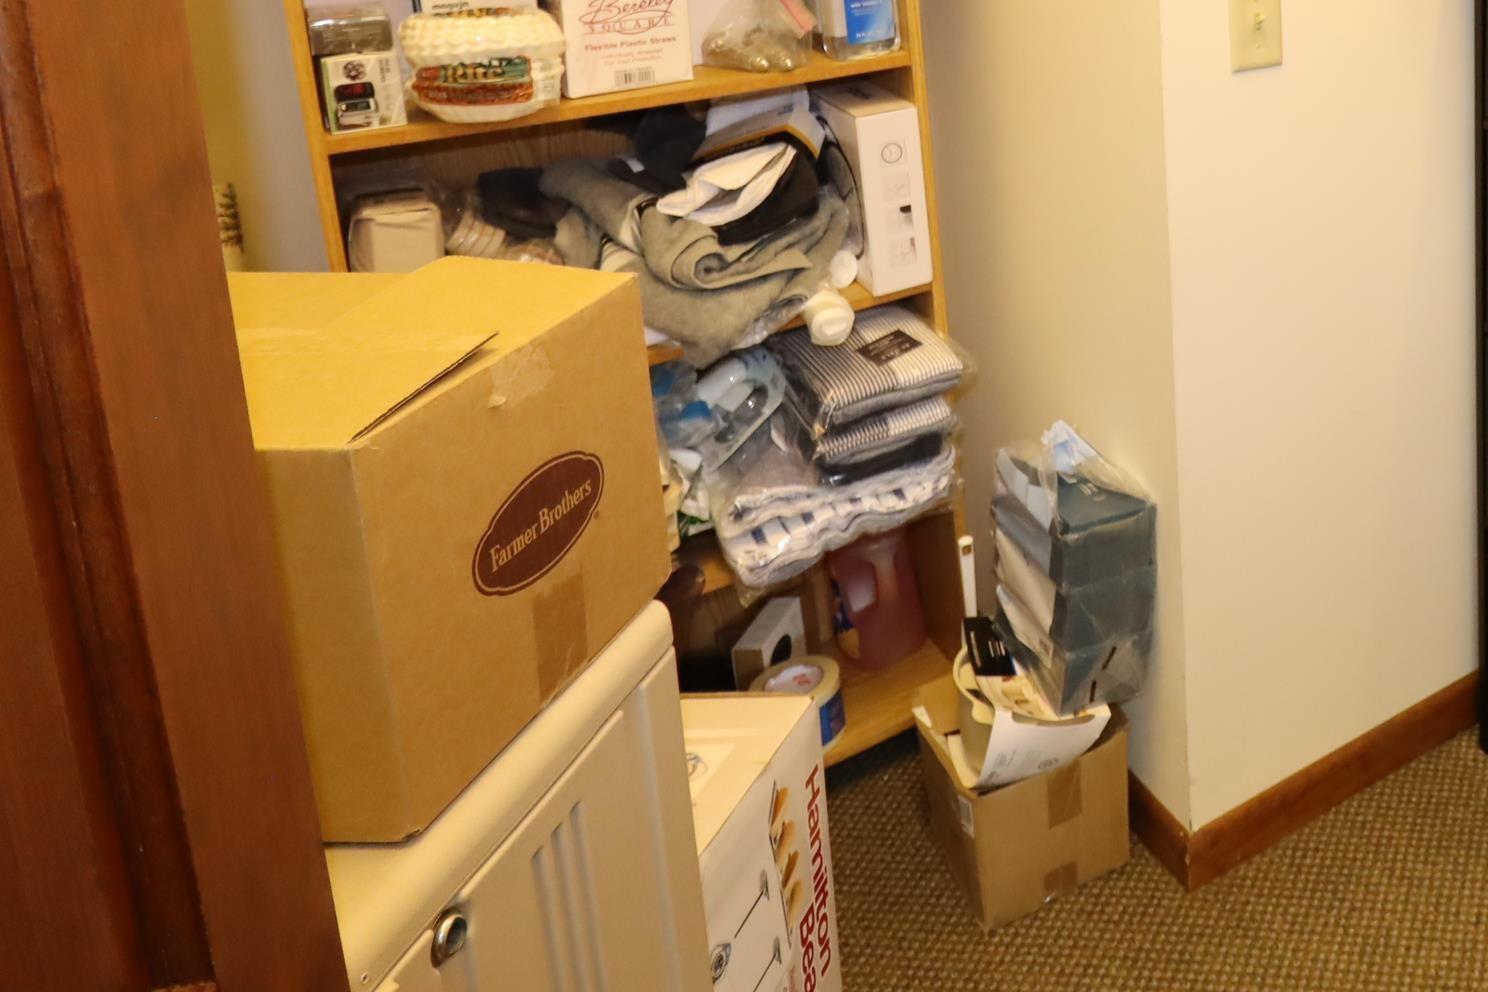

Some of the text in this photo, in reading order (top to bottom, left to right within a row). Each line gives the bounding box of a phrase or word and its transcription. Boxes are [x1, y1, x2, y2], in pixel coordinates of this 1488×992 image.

[490, 480, 592, 573] Farmer Brothers
[805, 765, 832, 977] Hamilton
[800, 903, 816, 992] Bea
